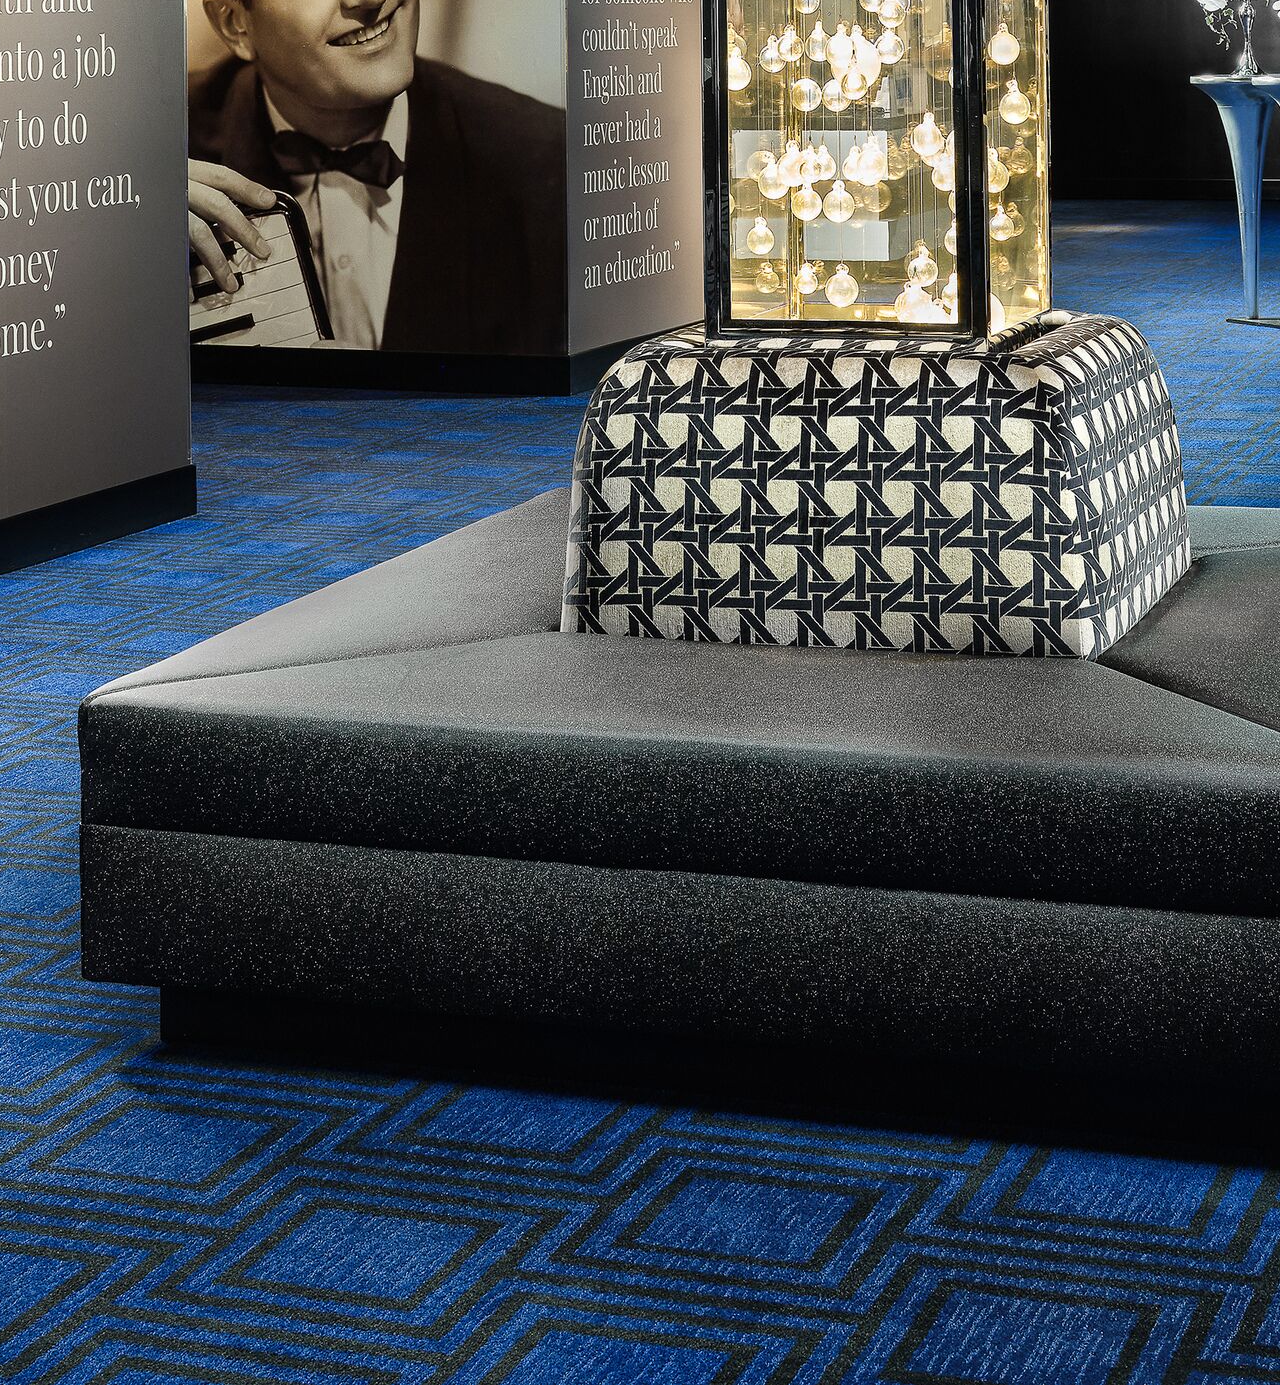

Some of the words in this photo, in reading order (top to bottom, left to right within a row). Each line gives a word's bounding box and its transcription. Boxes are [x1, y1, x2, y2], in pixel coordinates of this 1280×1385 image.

[582, 18, 639, 52] couldn’t
[641, 17, 679, 56] speak
[52, 48, 69, 80] a
[73, 33, 116, 89] job
[582, 64, 635, 105] English
[637, 62, 663, 95] and
[17, 109, 44, 150] to
[53, 100, 88, 146] do
[583, 120, 623, 147] never
[624, 108, 651, 142] had
[653, 116, 662, 139] a
[583, 158, 626, 194] music
[628, 156, 670, 188] lesson
[26, 179, 79, 227] you
[87, 173, 141, 210] can,
[583, 216, 601, 243] or
[602, 201, 643, 239] much
[645, 197, 660, 231] of
[584, 264, 602, 290] an
[604, 240, 680, 285] education.”
